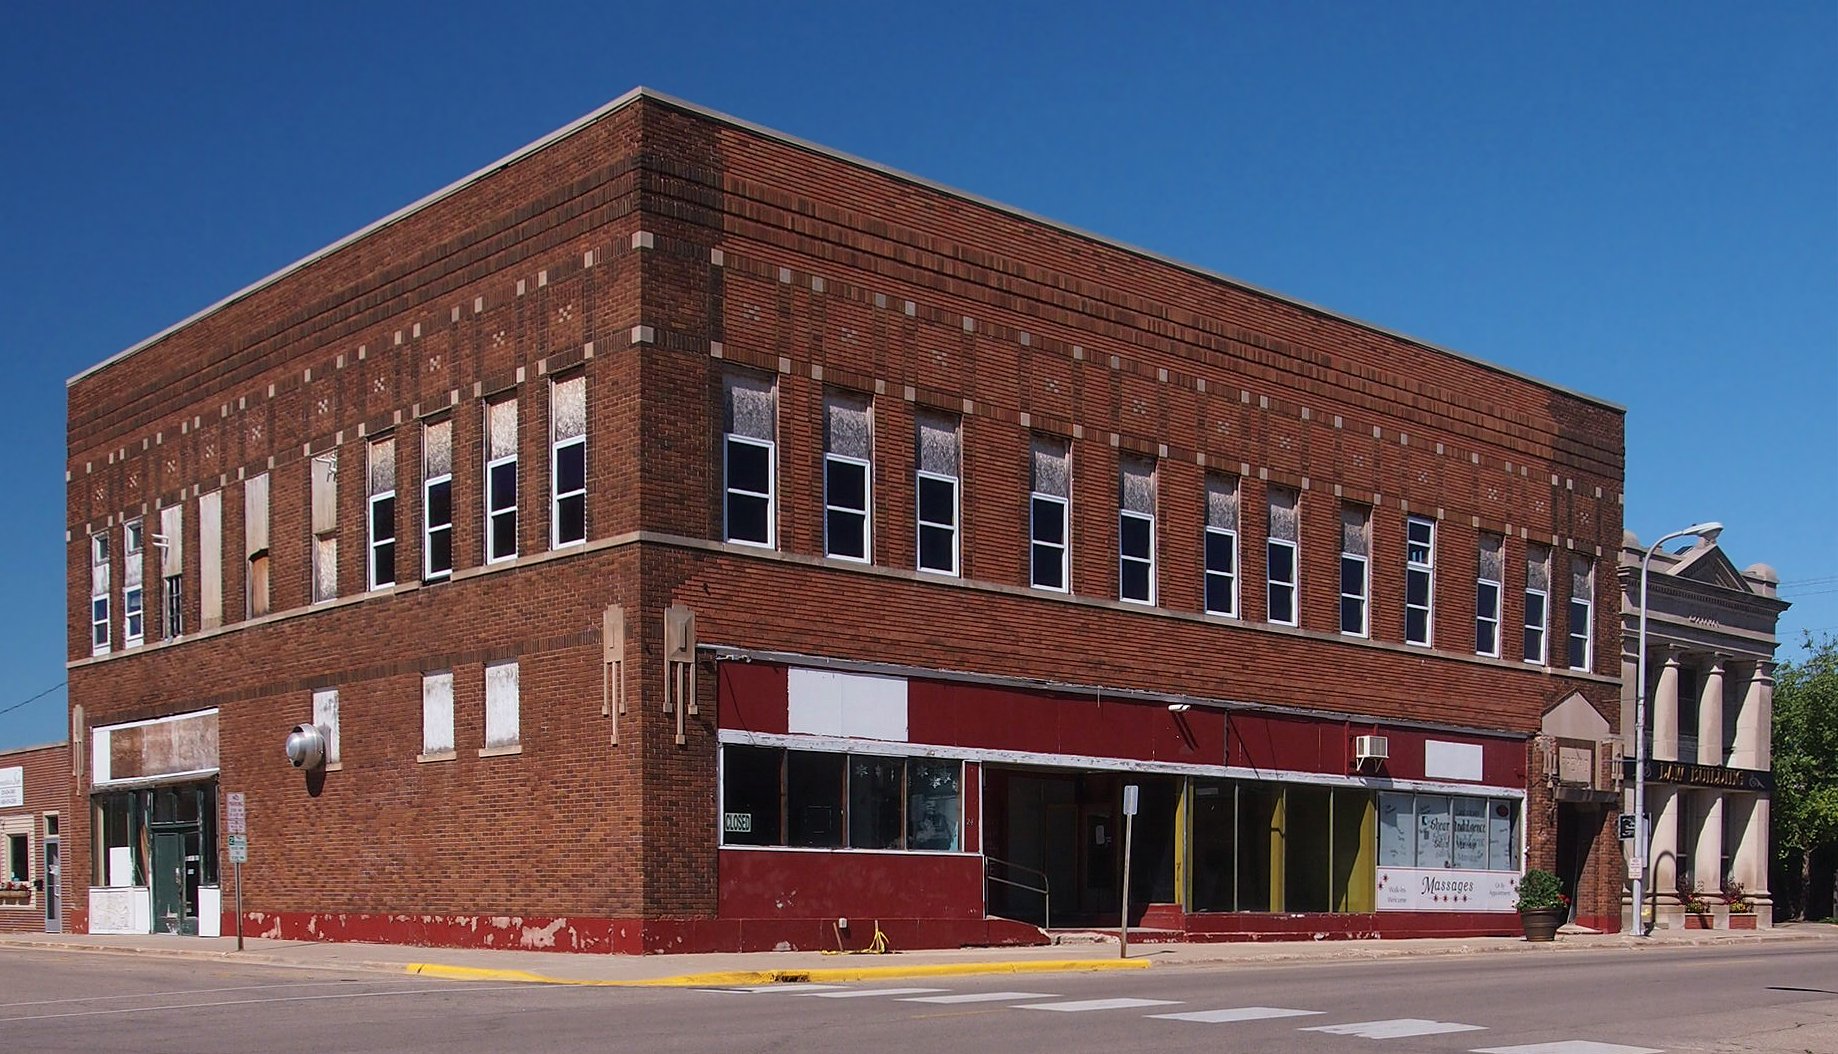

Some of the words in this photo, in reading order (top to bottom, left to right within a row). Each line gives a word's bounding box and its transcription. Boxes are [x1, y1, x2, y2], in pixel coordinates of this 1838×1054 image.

[1658, 762, 1685, 781] LAW
[1690, 765, 1745, 786] BUILDING
[726, 814, 750, 831] CLOSED
[1421, 876, 1474, 895] Massages
